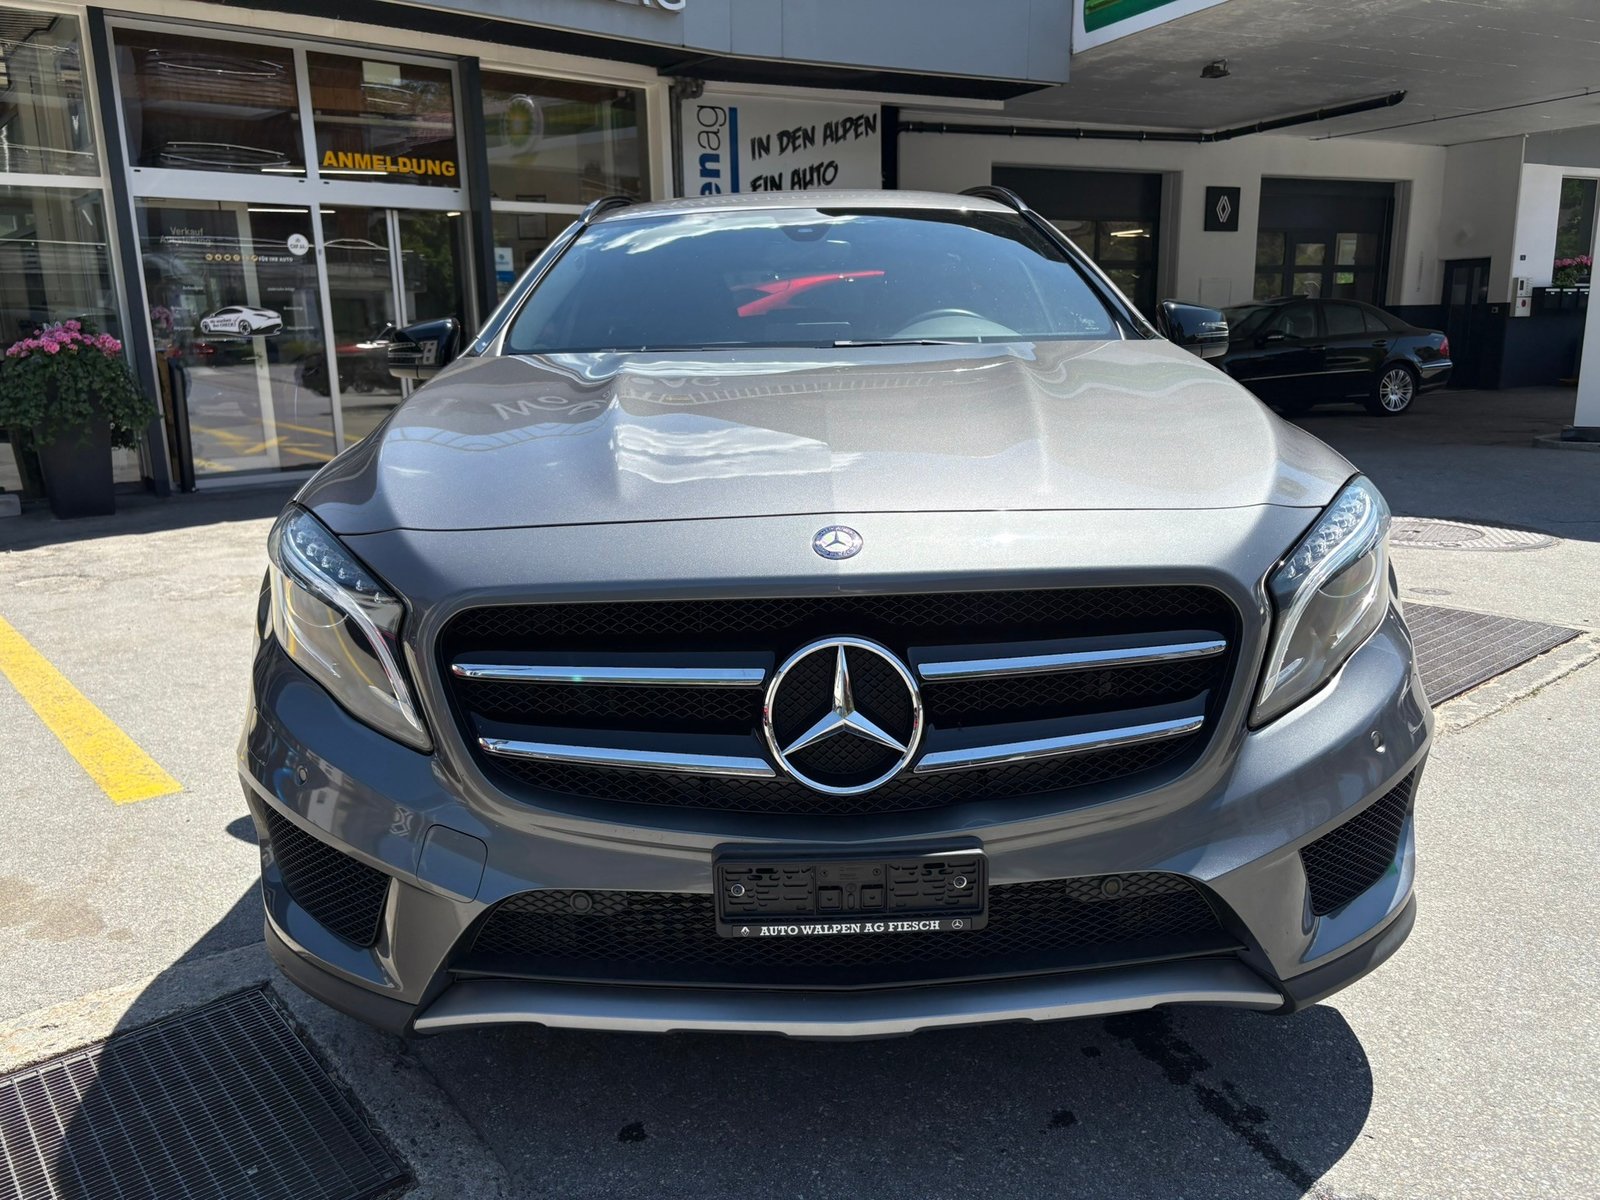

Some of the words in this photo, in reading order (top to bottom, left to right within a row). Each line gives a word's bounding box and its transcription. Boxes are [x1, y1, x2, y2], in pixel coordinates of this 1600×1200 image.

[750, 134, 771, 162] IN
[776, 125, 816, 156] DEN
[822, 113, 877, 146] ALPEN
[322, 150, 456, 177] ANMELDUNG
[790, 160, 839, 191] AUTO
[169, 226, 204, 236] Verkauf
[760, 925, 798, 936] AUTO
[800, 923, 861, 935] WALPEN
[864, 922, 884, 933] AG
[888, 920, 940, 932] FIESCH
